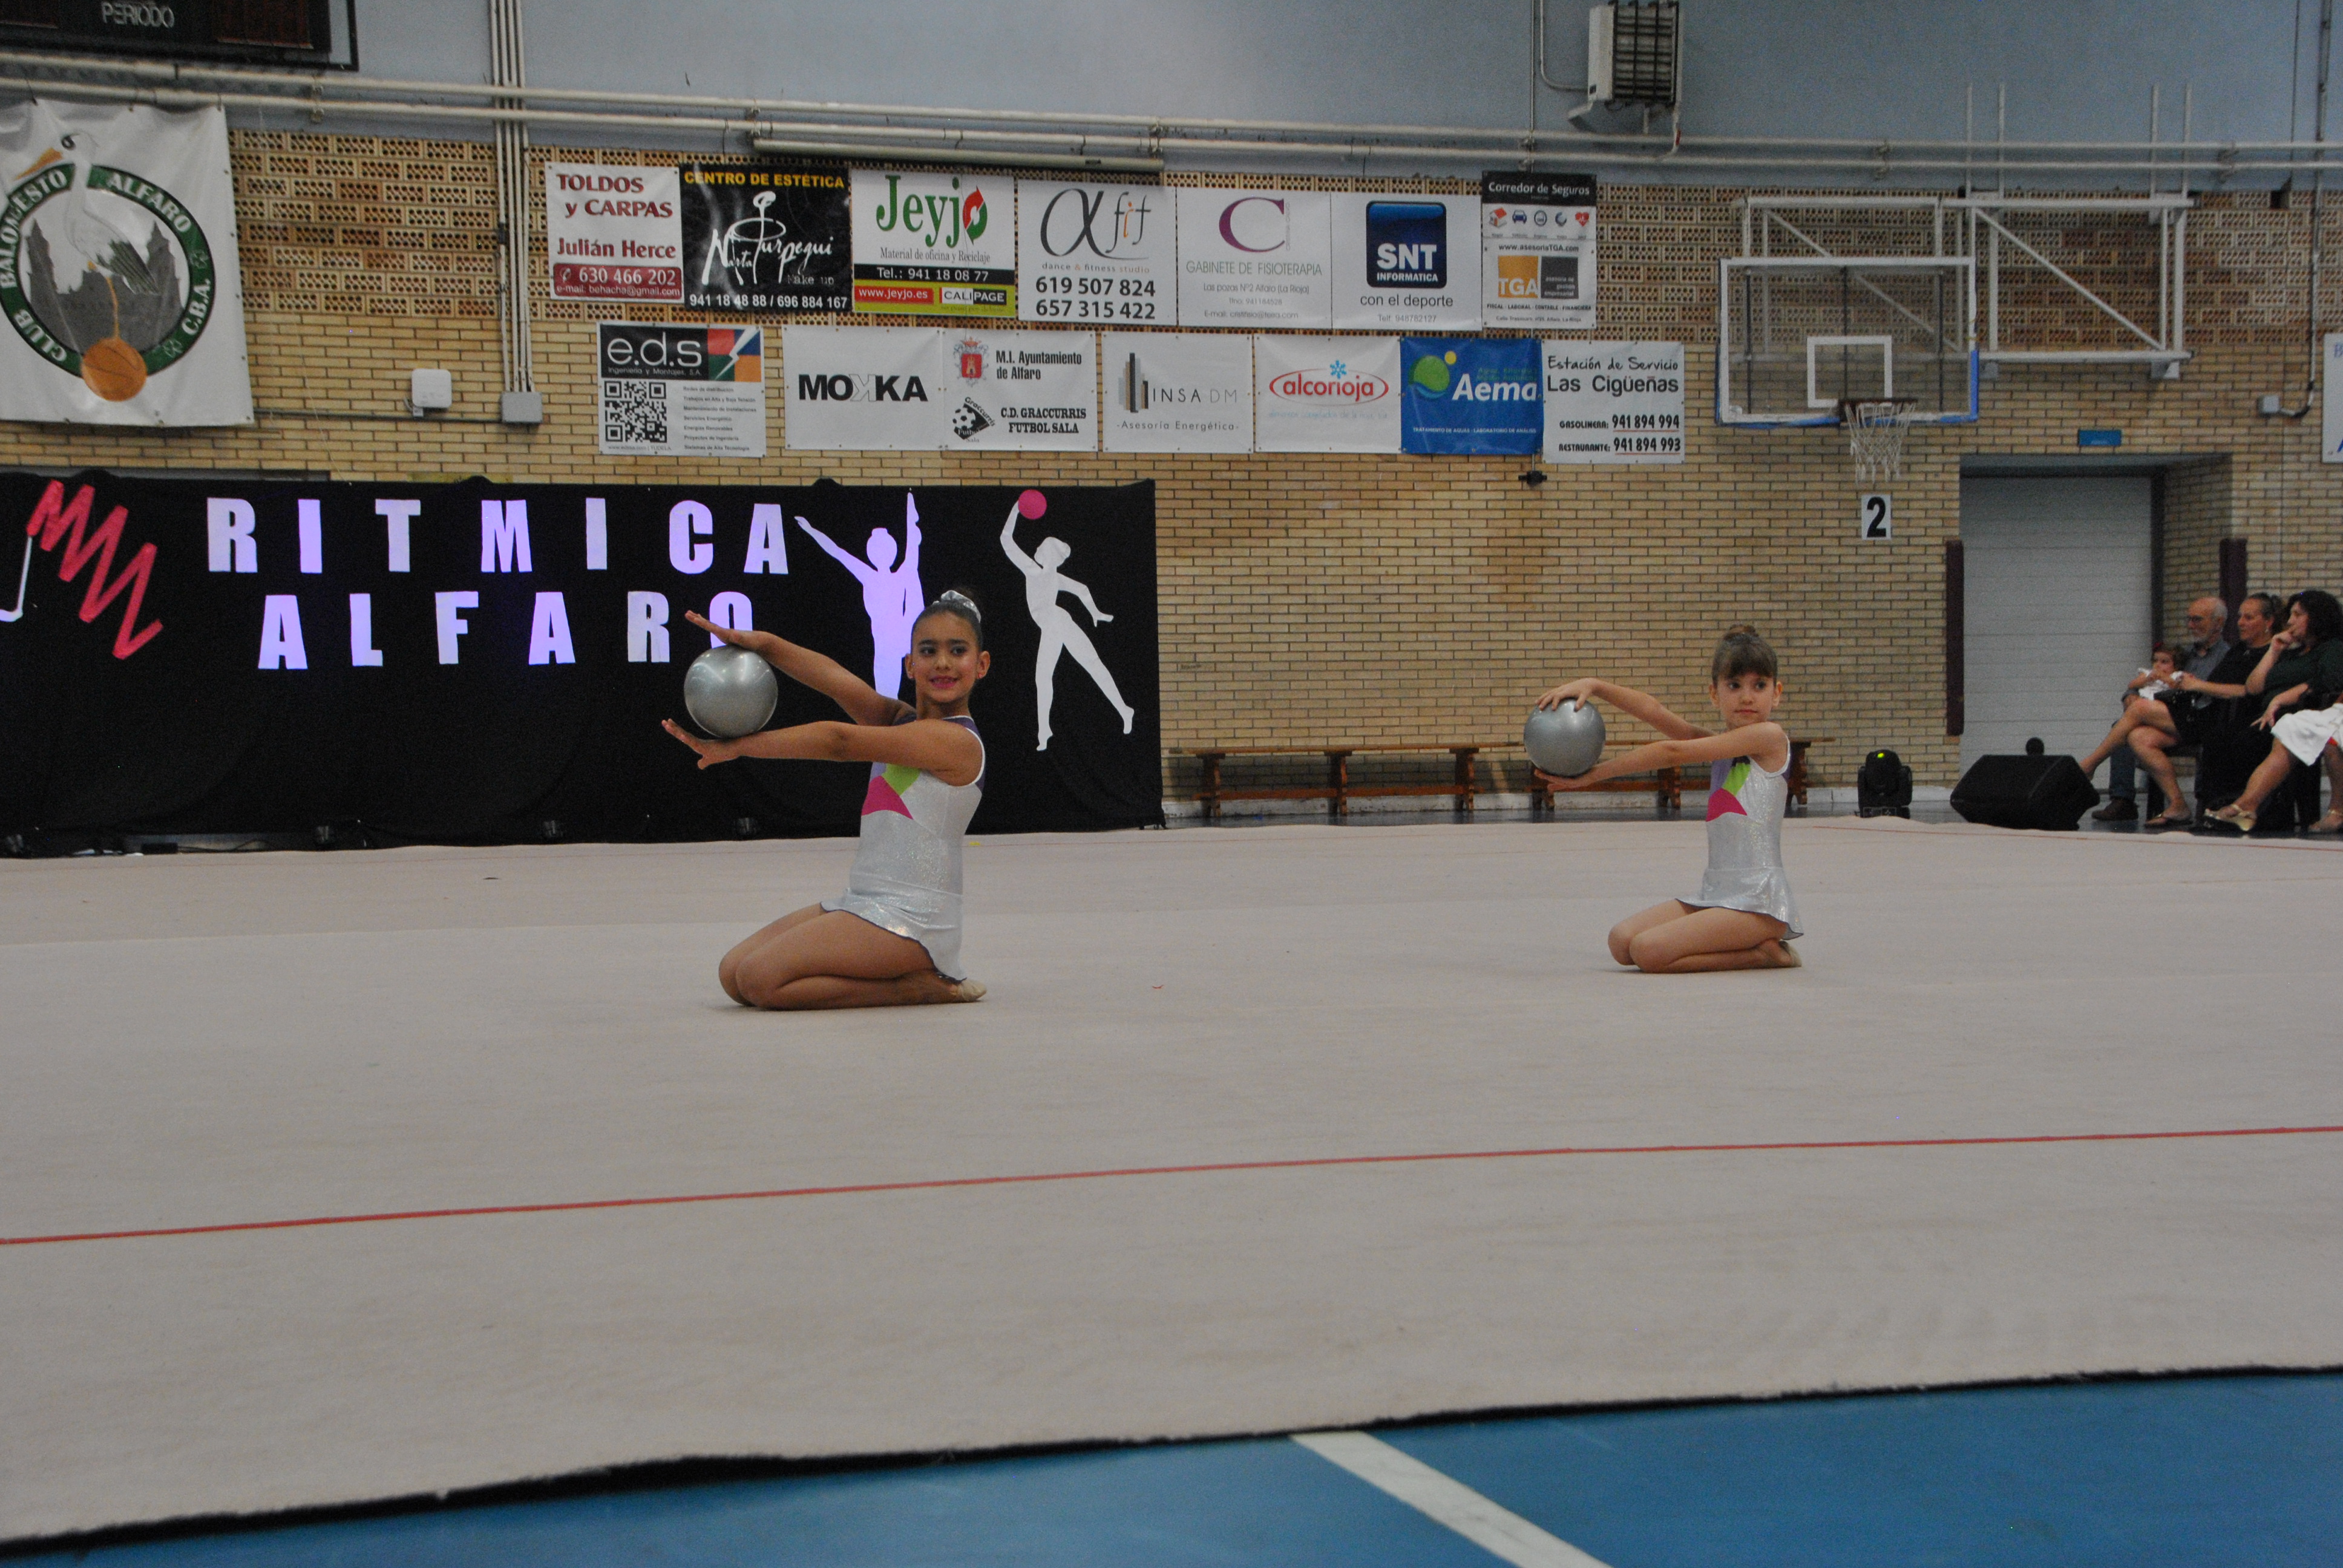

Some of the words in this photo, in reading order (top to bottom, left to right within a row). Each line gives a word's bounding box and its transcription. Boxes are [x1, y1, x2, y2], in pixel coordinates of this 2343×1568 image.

[102, 2, 174, 28] PERIODO
[556, 174, 644, 194] TOLDOS
[684, 171, 746, 185] CENTRO
[750, 173, 769, 186] DE
[1489, 181, 1535, 192] Corredor
[1537, 183, 1548, 194] de
[1552, 184, 1590, 197] Seguros
[106, 172, 191, 232] ALFARO
[565, 202, 578, 218] y
[585, 198, 673, 218] CARPAS
[876, 174, 988, 249] Jeyjo
[557, 237, 614, 257] Julián
[622, 240, 676, 258] Herce
[880, 247, 913, 259] Material
[914, 249, 923, 260] de
[925, 249, 949, 261] oficina
[952, 252, 956, 263] y
[958, 250, 990, 264] Reciclaje
[1498, 244, 1579, 252] www.asesoriaTGA.com
[1377, 243, 1437, 270] SNT
[908, 268, 930, 280] 941
[936, 269, 946, 281] 18
[955, 270, 969, 281] 08
[975, 271, 988, 282] 77
[1042, 262, 1070, 270] dance
[1085, 263, 1116, 272] fitness
[1119, 264, 1150, 273] studio
[1186, 260, 1234, 274] GABINETE
[1239, 262, 1253, 275] DE
[1258, 263, 1322, 276] FISIOTERAPIA
[579, 267, 608, 284] 630
[614, 268, 642, 285] 466
[648, 269, 676, 286] 202
[1377, 272, 1438, 282] INFORMATICA
[859, 289, 928, 299] www.jeyjo.es
[1036, 276, 1072, 294] 619
[1078, 278, 1113, 295] 507
[1119, 279, 1155, 297] 824
[1204, 283, 1215, 292] Las
[1216, 284, 1238, 293] pozas
[1255, 284, 1276, 293] Alfaro
[1290, 284, 1309, 295] Rioja)
[1498, 278, 1538, 295] TGA
[689, 294, 710, 307] 941
[716, 294, 730, 307] 18
[733, 295, 749, 307] 48
[752, 295, 766, 307] 88
[778, 295, 798, 307] 696
[802, 296, 822, 308] 884
[827, 296, 847, 309] 167
[1036, 299, 1072, 316] 657
[1078, 301, 1114, 318] 315
[1119, 302, 1155, 319] 422
[1360, 296, 1383, 305] con
[1388, 294, 1399, 306] el
[1404, 294, 1453, 309] deporte
[13, 309, 67, 362] CLUB
[608, 332, 702, 367] e.d.s
[996, 350, 1015, 364] M.I.
[1018, 350, 1082, 366] Ayuntamiento
[1548, 356, 1601, 370] Estación
[1608, 357, 1623, 370] de
[1628, 357, 1678, 371] Servicio
[997, 367, 1008, 379] de
[1011, 367, 1041, 380] Alfaro
[1283, 373, 1374, 402] alcorioja
[1452, 373, 1537, 401] Aema
[1547, 375, 1581, 392] Las
[1592, 375, 1679, 397] Cigüeñas
[1153, 388, 1201, 403] INSA
[1210, 388, 1237, 403] DM
[1000, 407, 1019, 418] C.D.
[1020, 407, 1086, 419] GRACCURRIS
[1009, 422, 1050, 433] FUTBOL
[1052, 422, 1079, 434] SALA
[1612, 414, 1631, 428] 941
[1634, 414, 1655, 429] 894
[1659, 414, 1679, 428] 994
[1614, 437, 1633, 451] 941
[1636, 437, 1657, 451] 894
[1660, 437, 1681, 451] 993
[1867, 497, 1886, 537] 2
[207, 497, 788, 574] RITMICA
